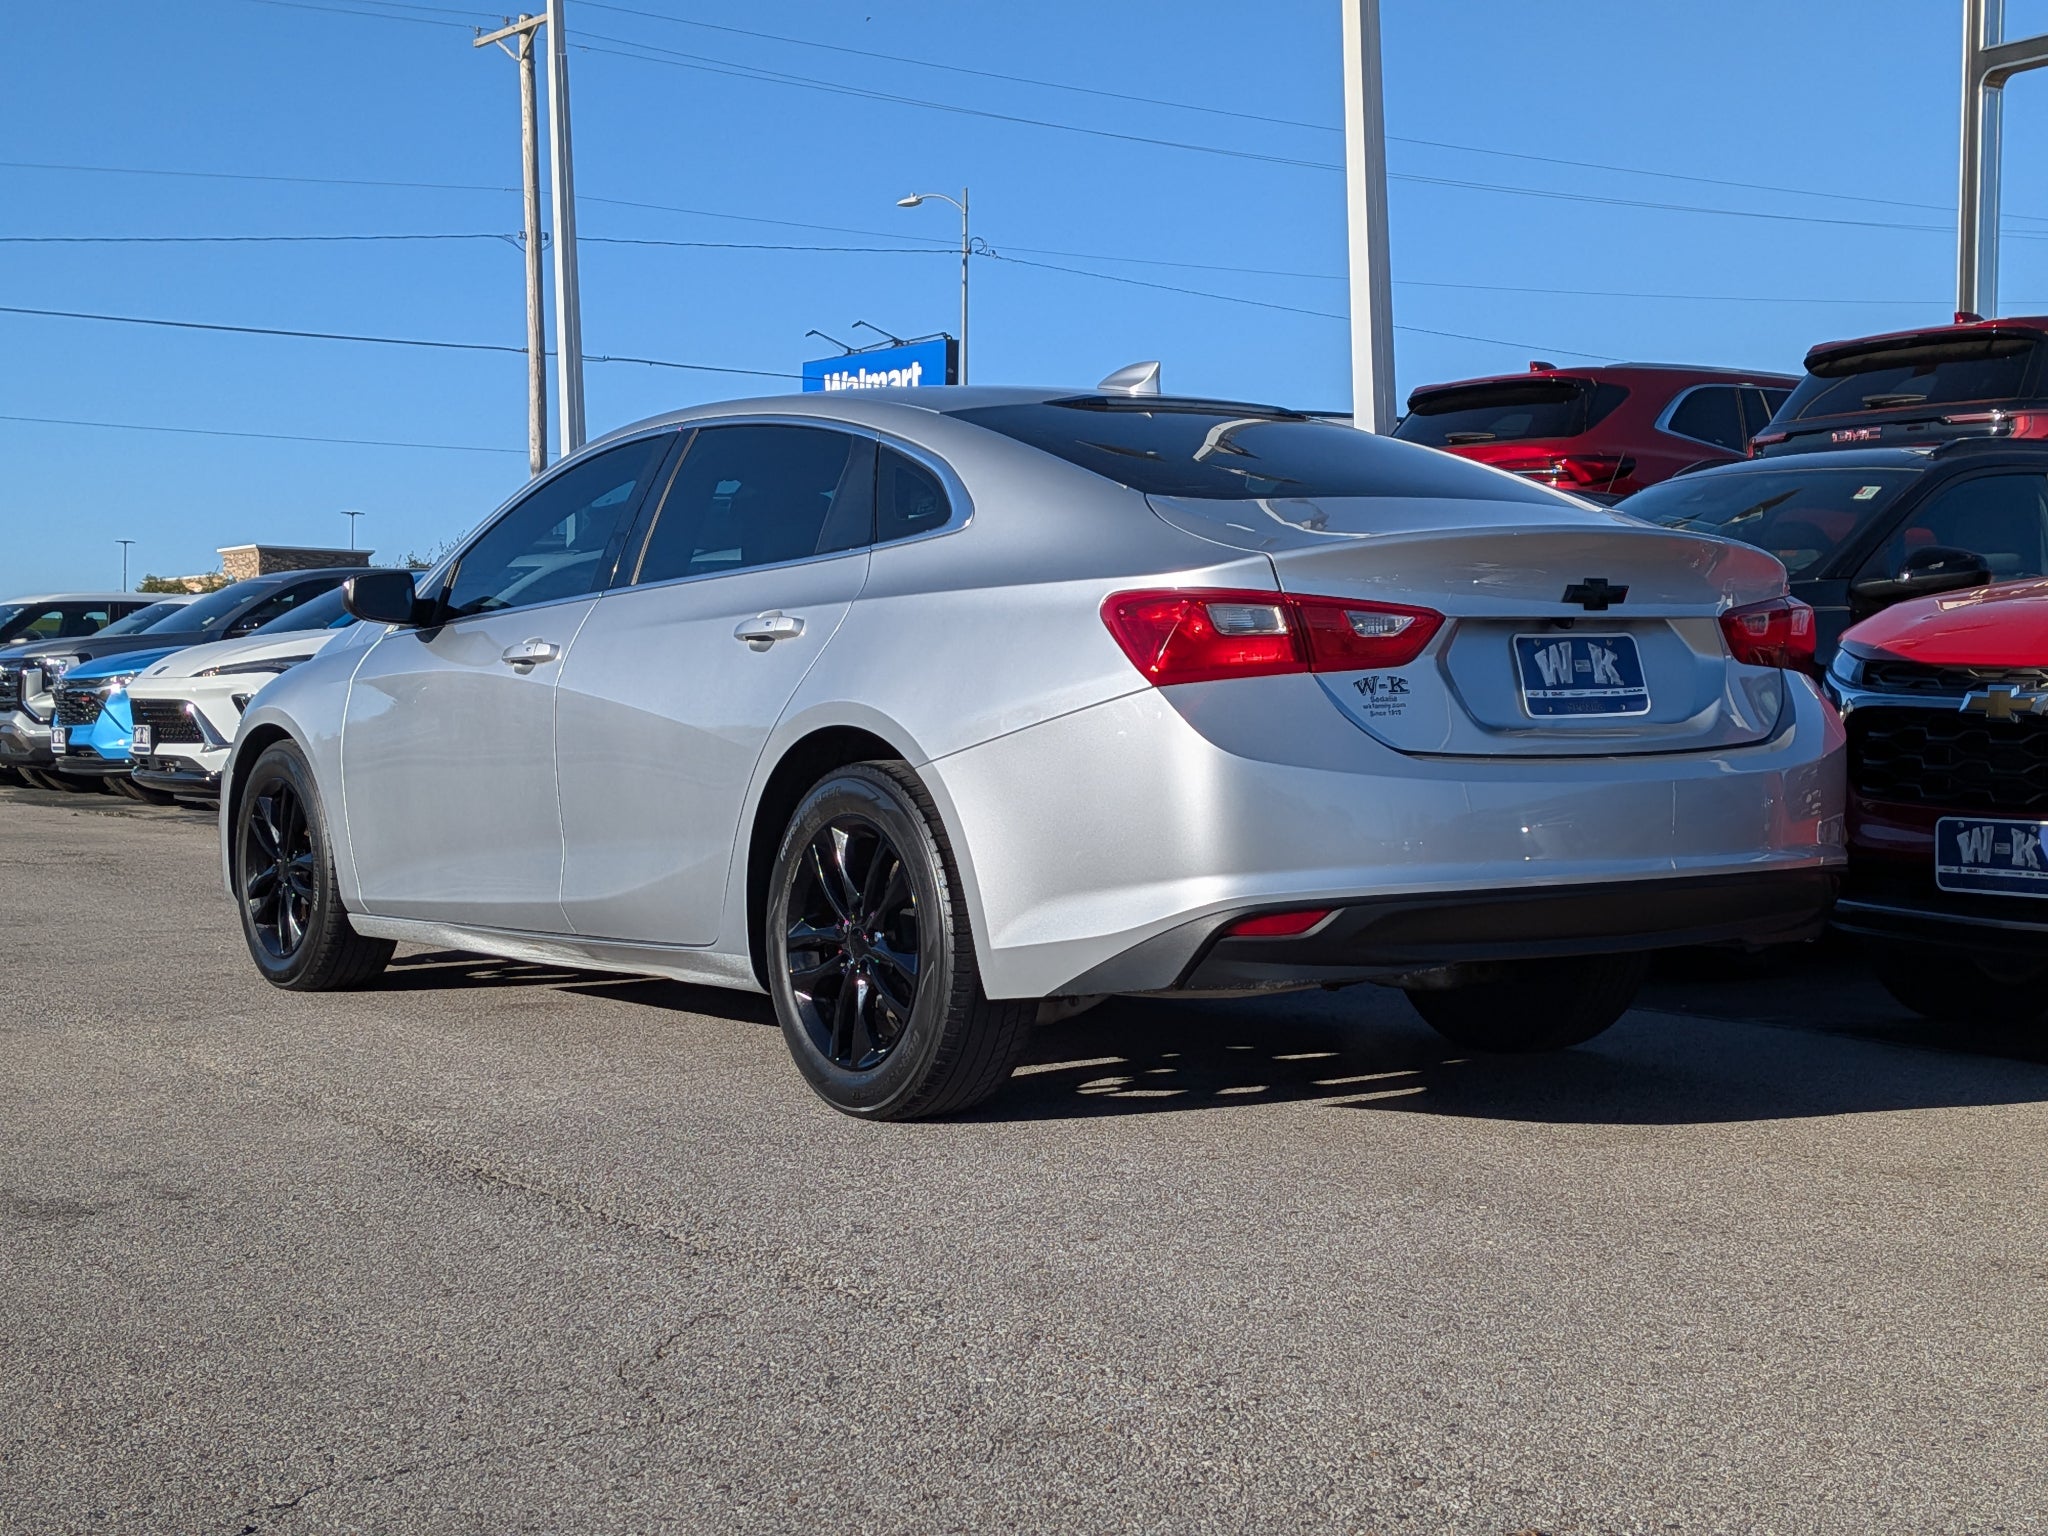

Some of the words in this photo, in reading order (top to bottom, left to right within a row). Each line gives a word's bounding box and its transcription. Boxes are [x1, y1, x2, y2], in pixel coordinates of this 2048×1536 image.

[823, 362, 922, 392] Walmart
[1534, 641, 1625, 687] W-K
[1353, 675, 1411, 696] W-K
[1956, 825, 2040, 870] W-K
